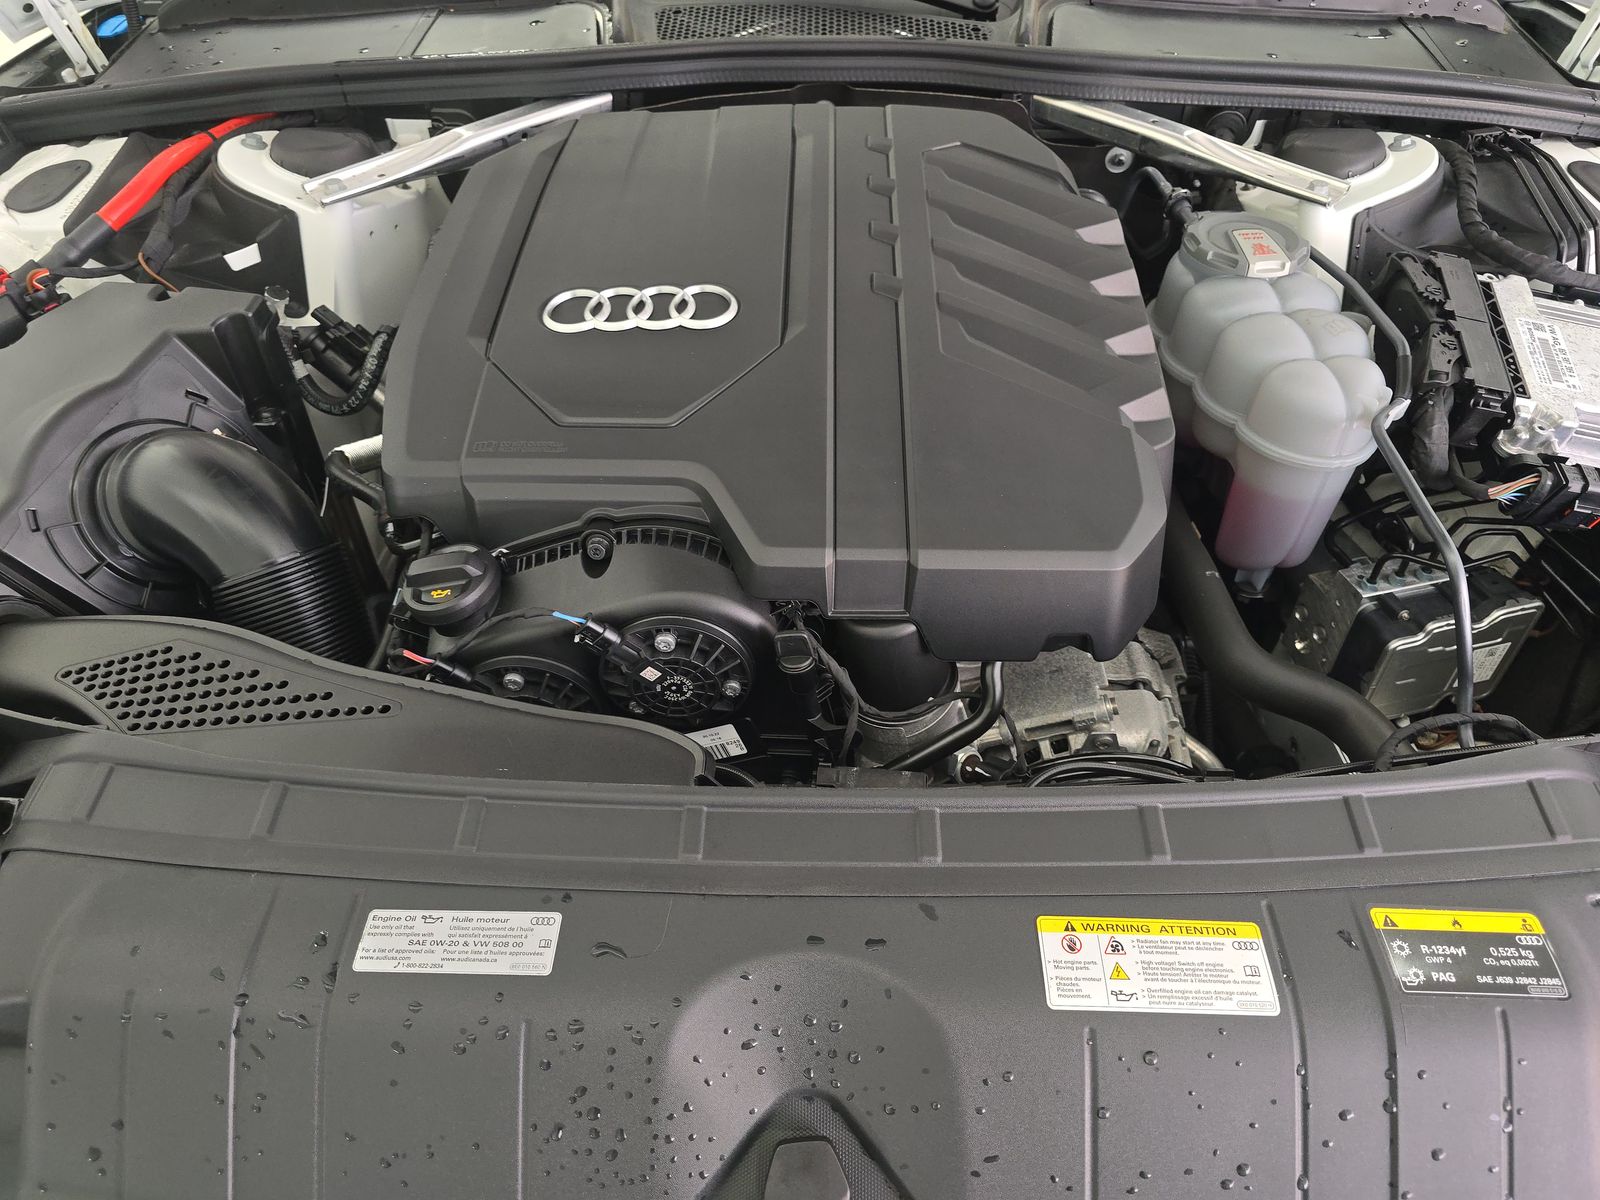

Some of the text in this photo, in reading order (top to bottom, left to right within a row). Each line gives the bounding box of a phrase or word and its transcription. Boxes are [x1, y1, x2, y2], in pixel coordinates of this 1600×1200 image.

[372, 914, 402, 922] Engine
[1081, 923, 1237, 936] WARNING ATTENTION
[1420, 945, 1534, 958] R-1234yf 0,525 kg
[1431, 972, 1456, 982] PAG
